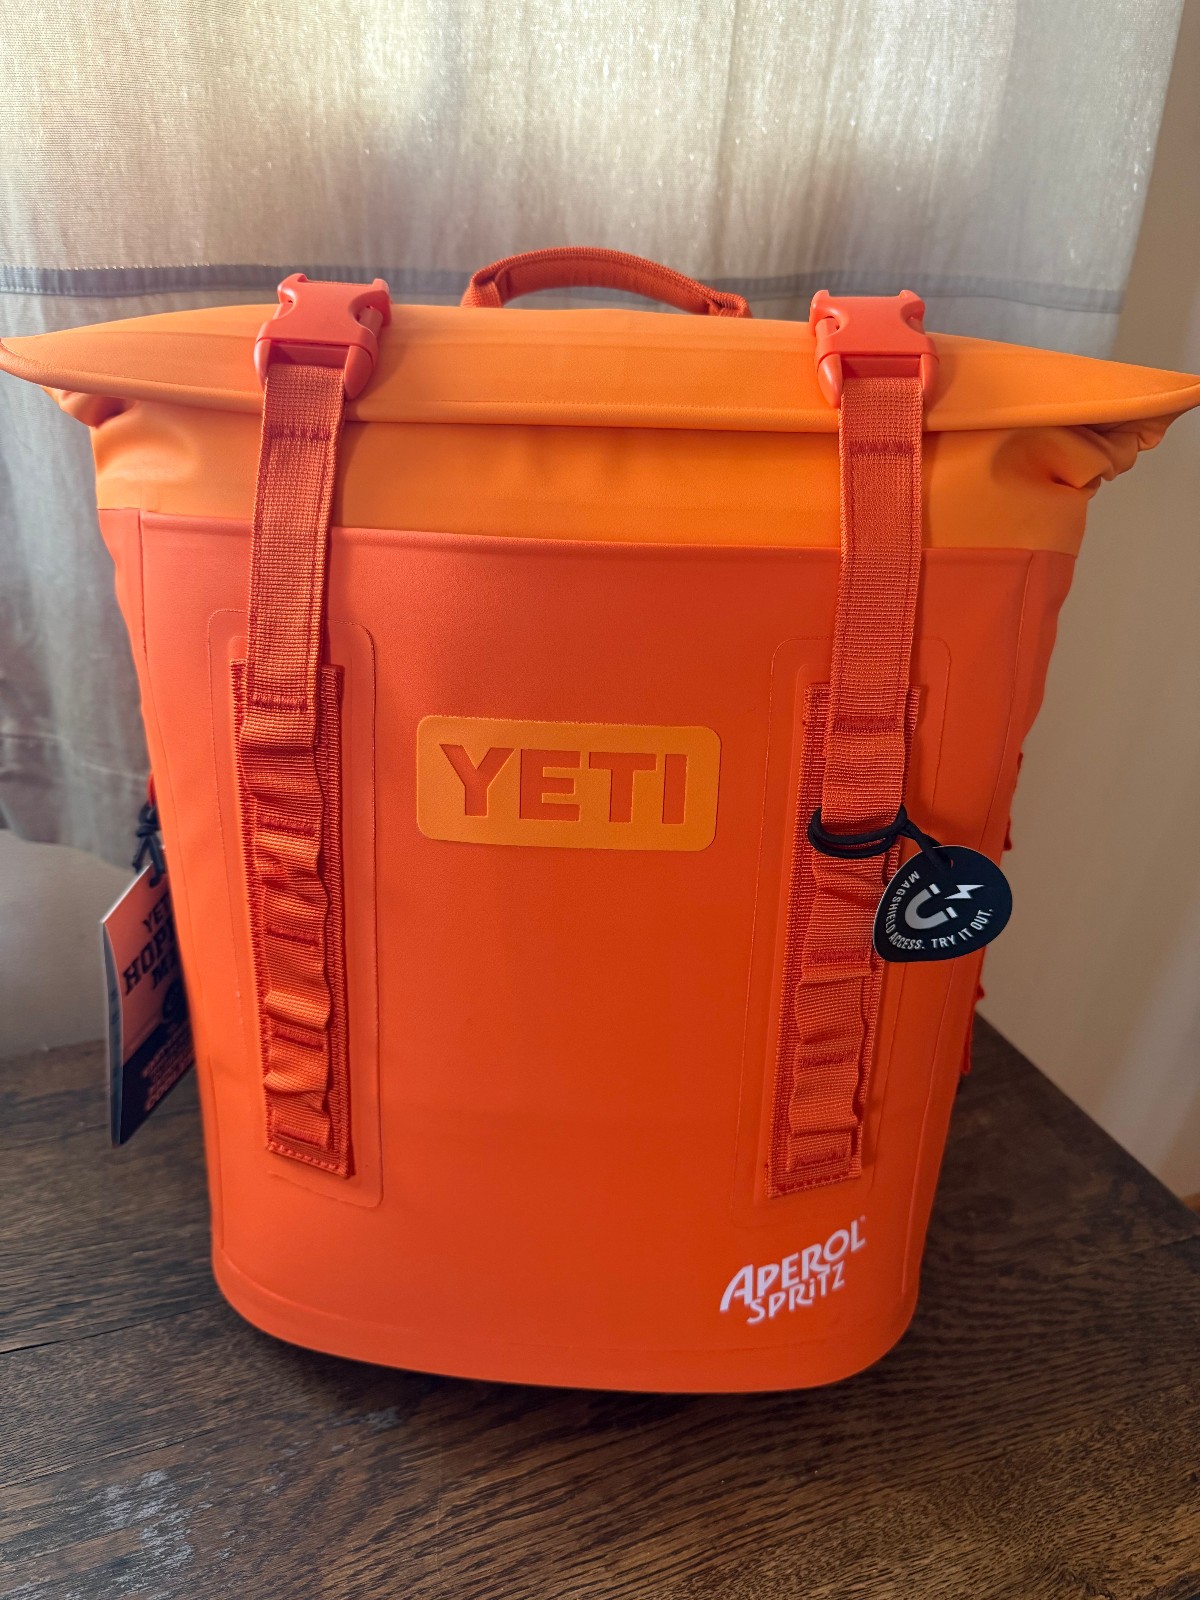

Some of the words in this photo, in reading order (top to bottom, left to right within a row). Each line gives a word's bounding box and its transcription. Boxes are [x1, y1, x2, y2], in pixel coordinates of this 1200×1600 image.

[439, 743, 688, 825] YETI
[885, 870, 920, 934] MAGSHIELD
[970, 908, 994, 931] OUT.
[888, 931, 925, 950] ACCESS.
[931, 934, 956, 949] TRY
[957, 927, 974, 942] IT
[719, 1219, 866, 1312] APEROL
